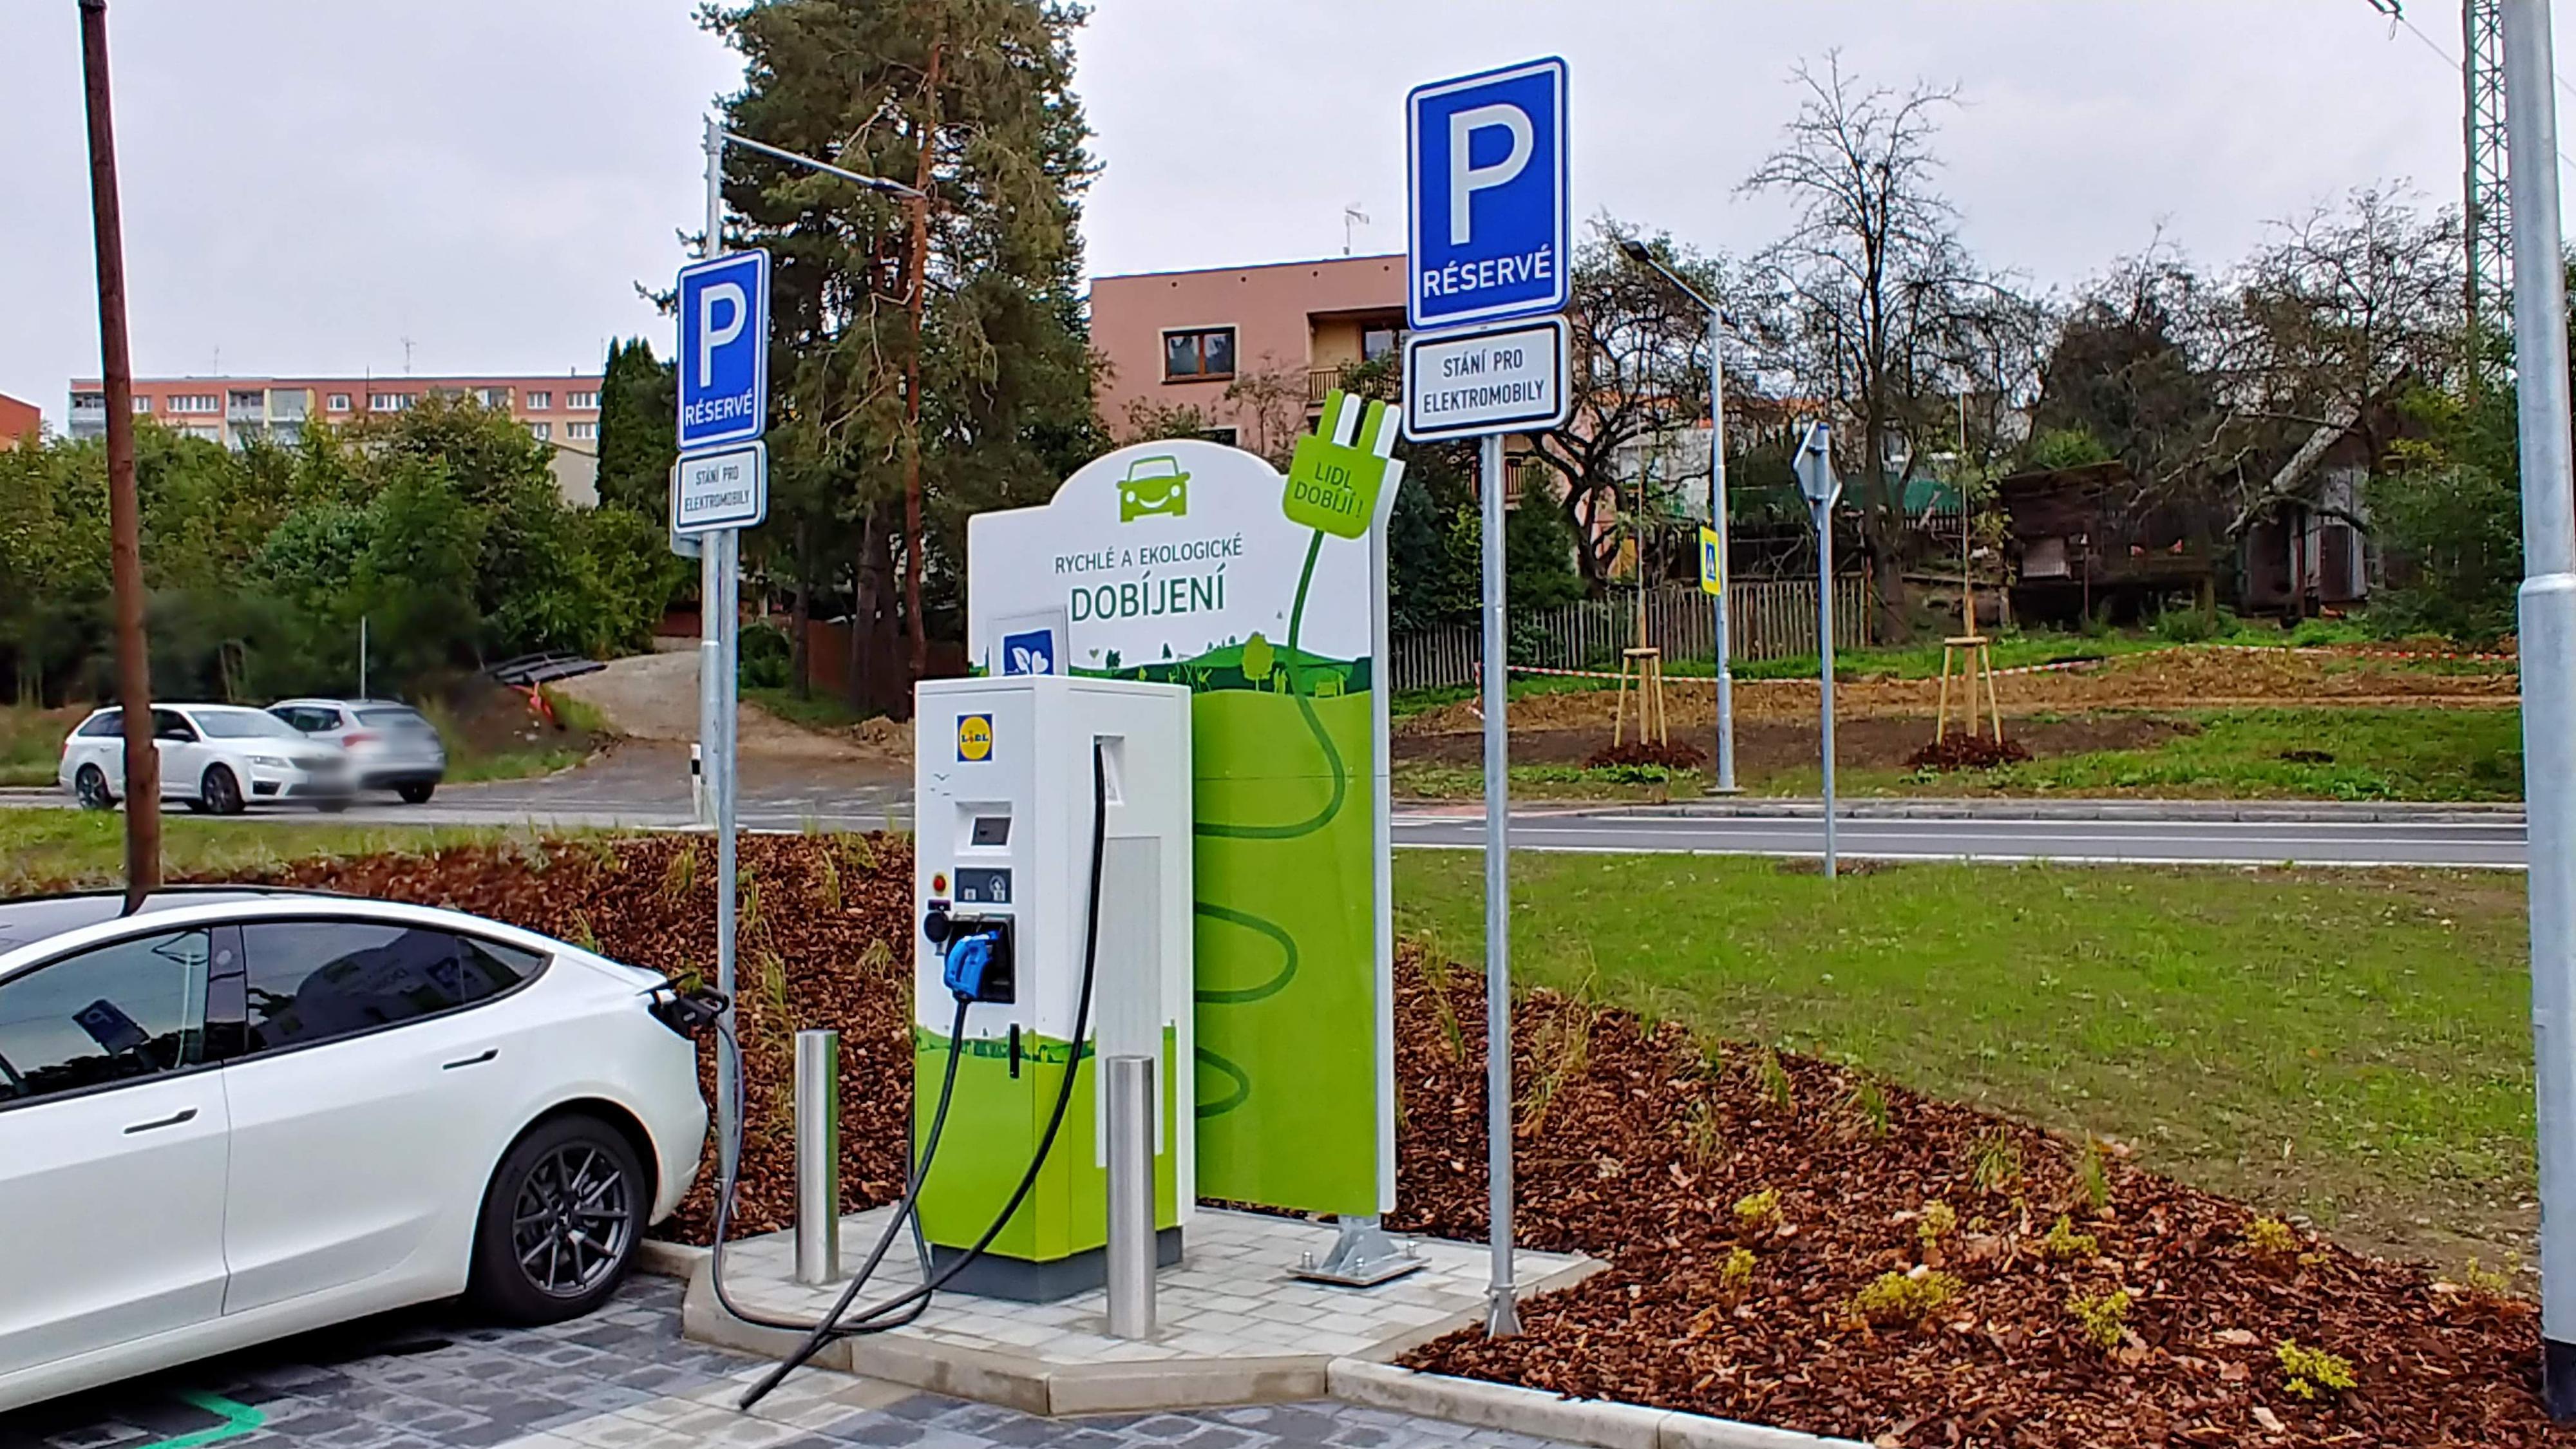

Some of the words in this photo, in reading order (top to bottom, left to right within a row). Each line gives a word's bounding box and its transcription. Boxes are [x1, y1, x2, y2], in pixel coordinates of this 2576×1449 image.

[1450, 104, 1533, 246] P
[1423, 243, 1551, 298] RÉSERVÉ
[699, 282, 747, 388] P
[1443, 349, 1487, 378] STÁNÍ
[1493, 348, 1523, 372] PRO
[685, 388, 753, 427] RÉSERVÉ
[1423, 379, 1544, 414] ELEKTROMOBILY
[723, 466, 739, 483] PRO
[1314, 461, 1353, 490] LIDL
[685, 490, 750, 512] ELEKTROMOBILY
[1294, 480, 1357, 516] DOBÍJÍ
[1055, 545, 1115, 574] RYCHLÉ
[1121, 549, 1133, 567] A
[1139, 531, 1244, 566] EKOLOGICKÉ
[1071, 562, 1226, 622] DOBÍJENÍ
